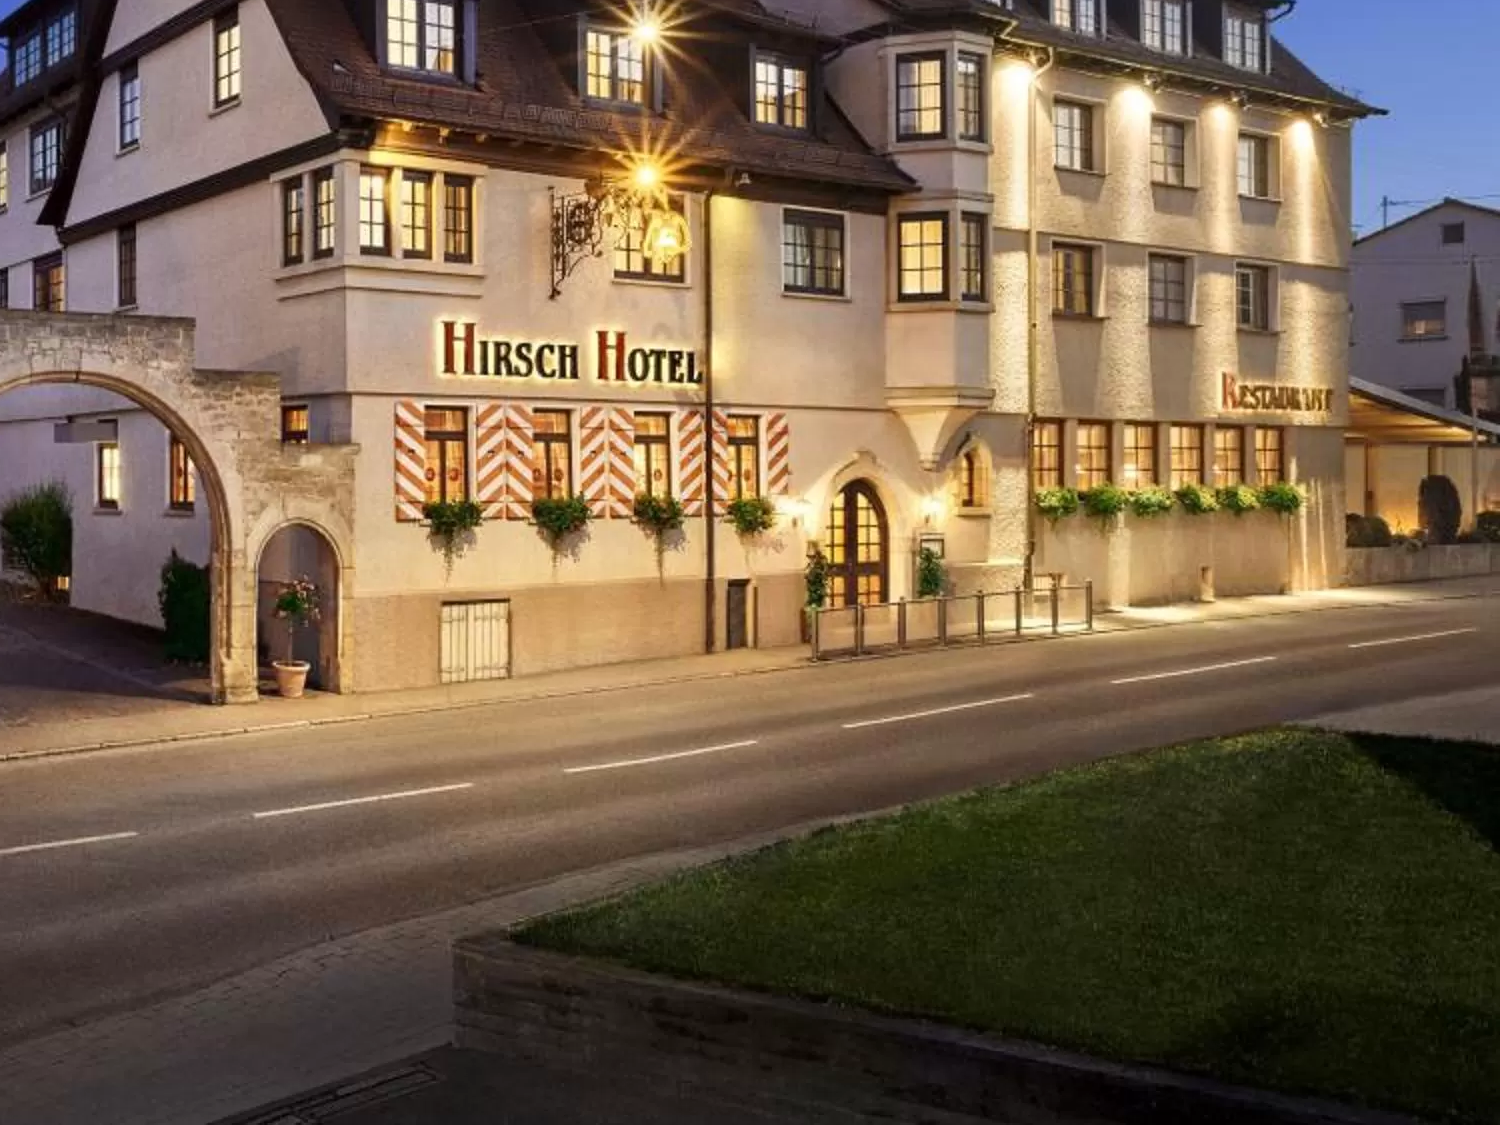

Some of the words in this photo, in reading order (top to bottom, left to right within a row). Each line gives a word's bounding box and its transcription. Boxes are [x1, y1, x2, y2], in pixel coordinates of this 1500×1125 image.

[442, 321, 580, 380] HIRSCH
[596, 330, 703, 384] HOTEL
[1222, 372, 1333, 411] RESTAURANT
